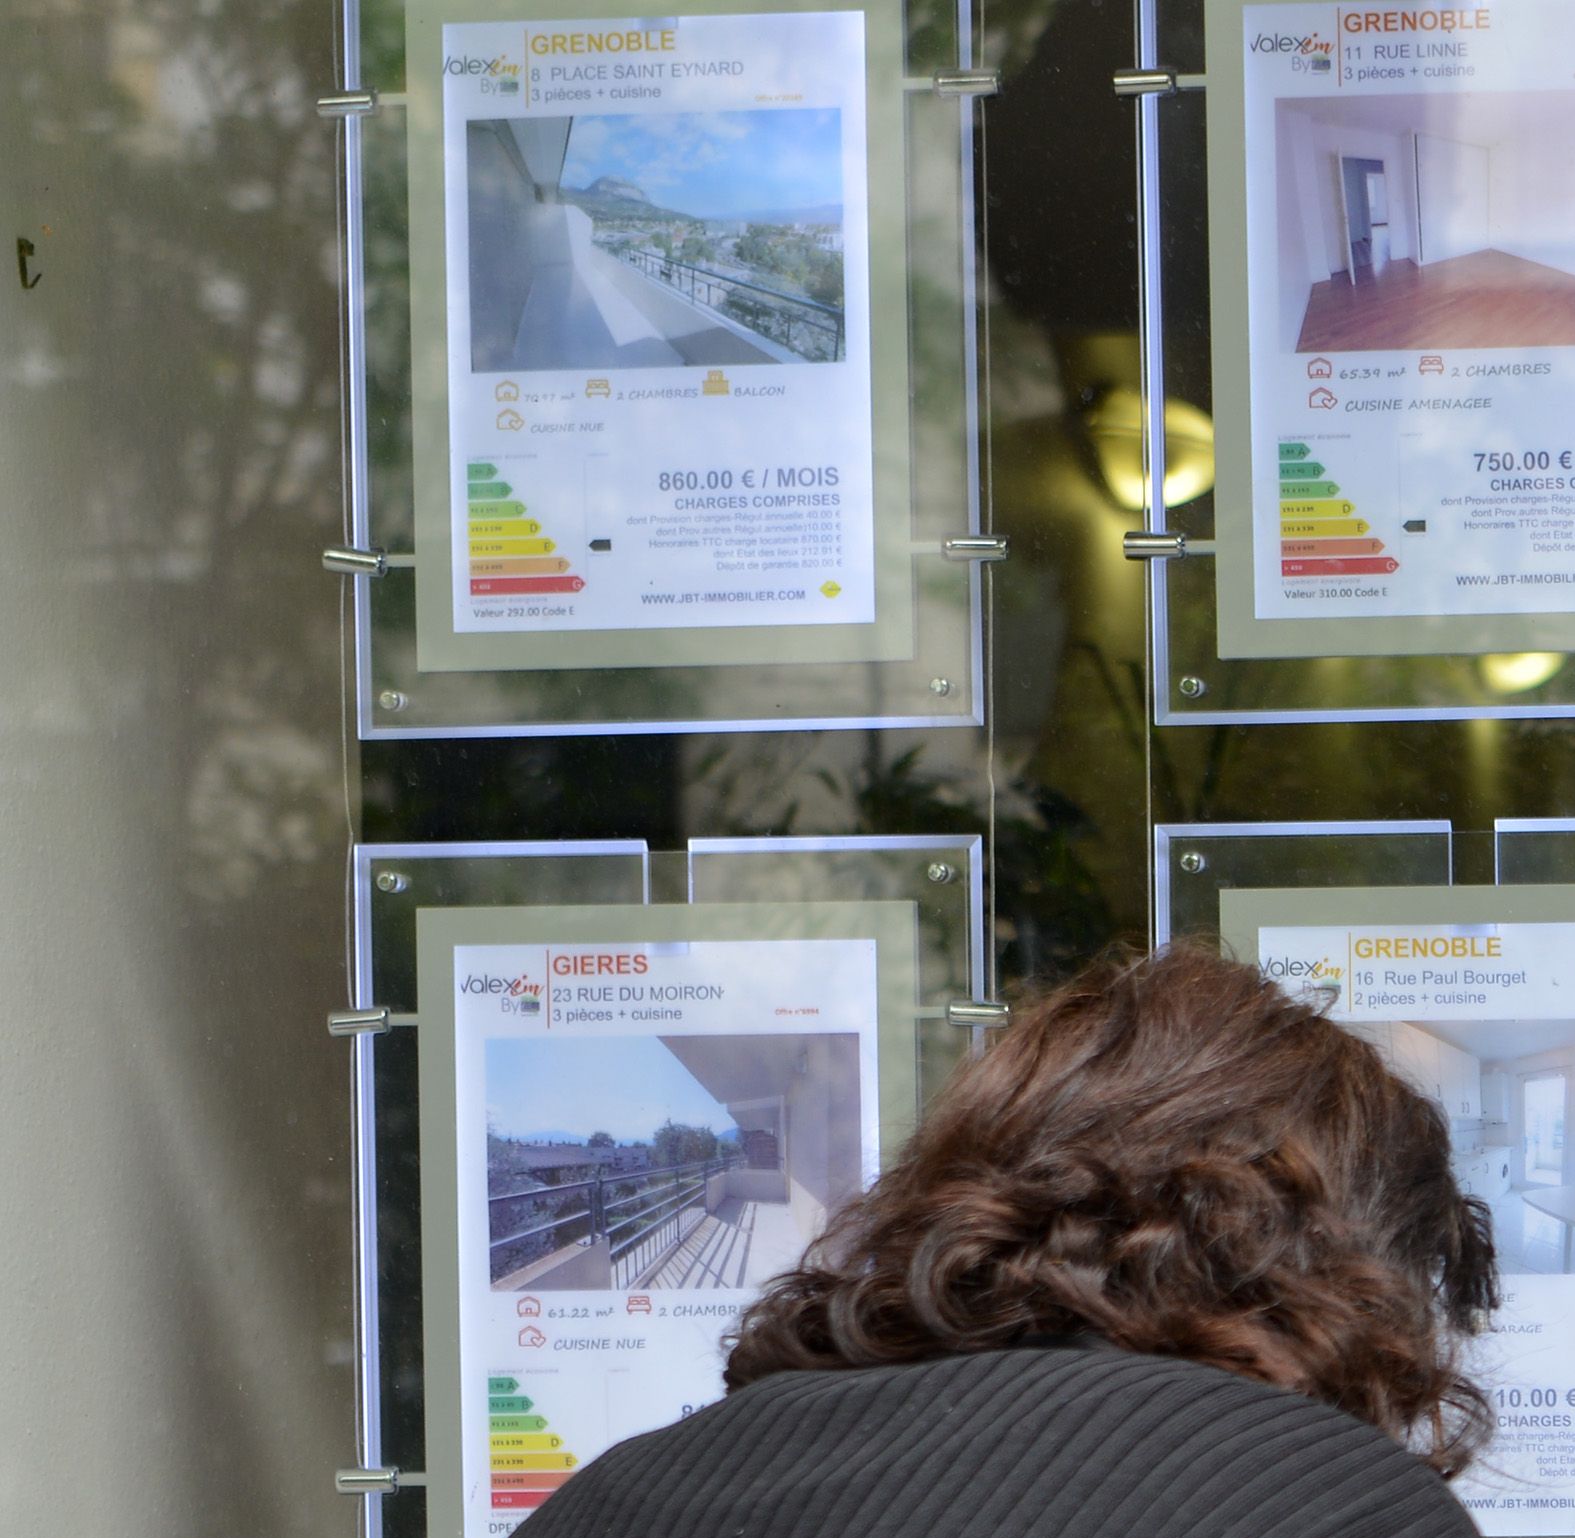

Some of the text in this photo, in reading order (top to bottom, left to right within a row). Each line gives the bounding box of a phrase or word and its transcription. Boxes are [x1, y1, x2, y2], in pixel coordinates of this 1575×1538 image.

[1343, 9, 1489, 34] GRENOBLE
[530, 28, 675, 55] GRENOBLE
[1344, 42, 1467, 61] 11 RUE LINNE
[526, 60, 744, 86] 8 PLACE SAINT EYNARD
[1473, 450, 1550, 472] 750.00
[1558, 450, 1573, 470] €
[658, 469, 733, 492] 860.00
[741, 469, 755, 489] €
[776, 466, 839, 488] MOIS
[674, 493, 841, 511] CHARGES COMPRISES
[1355, 937, 1501, 959] GRENOBLE
[552, 954, 648, 976] GIERES
[1354, 969, 1527, 988] 16 Rue Paul Bourget
[552, 985, 722, 1003] 23 RUE DU MOIRON
[1496, 1415, 1572, 1428] CHARGES
